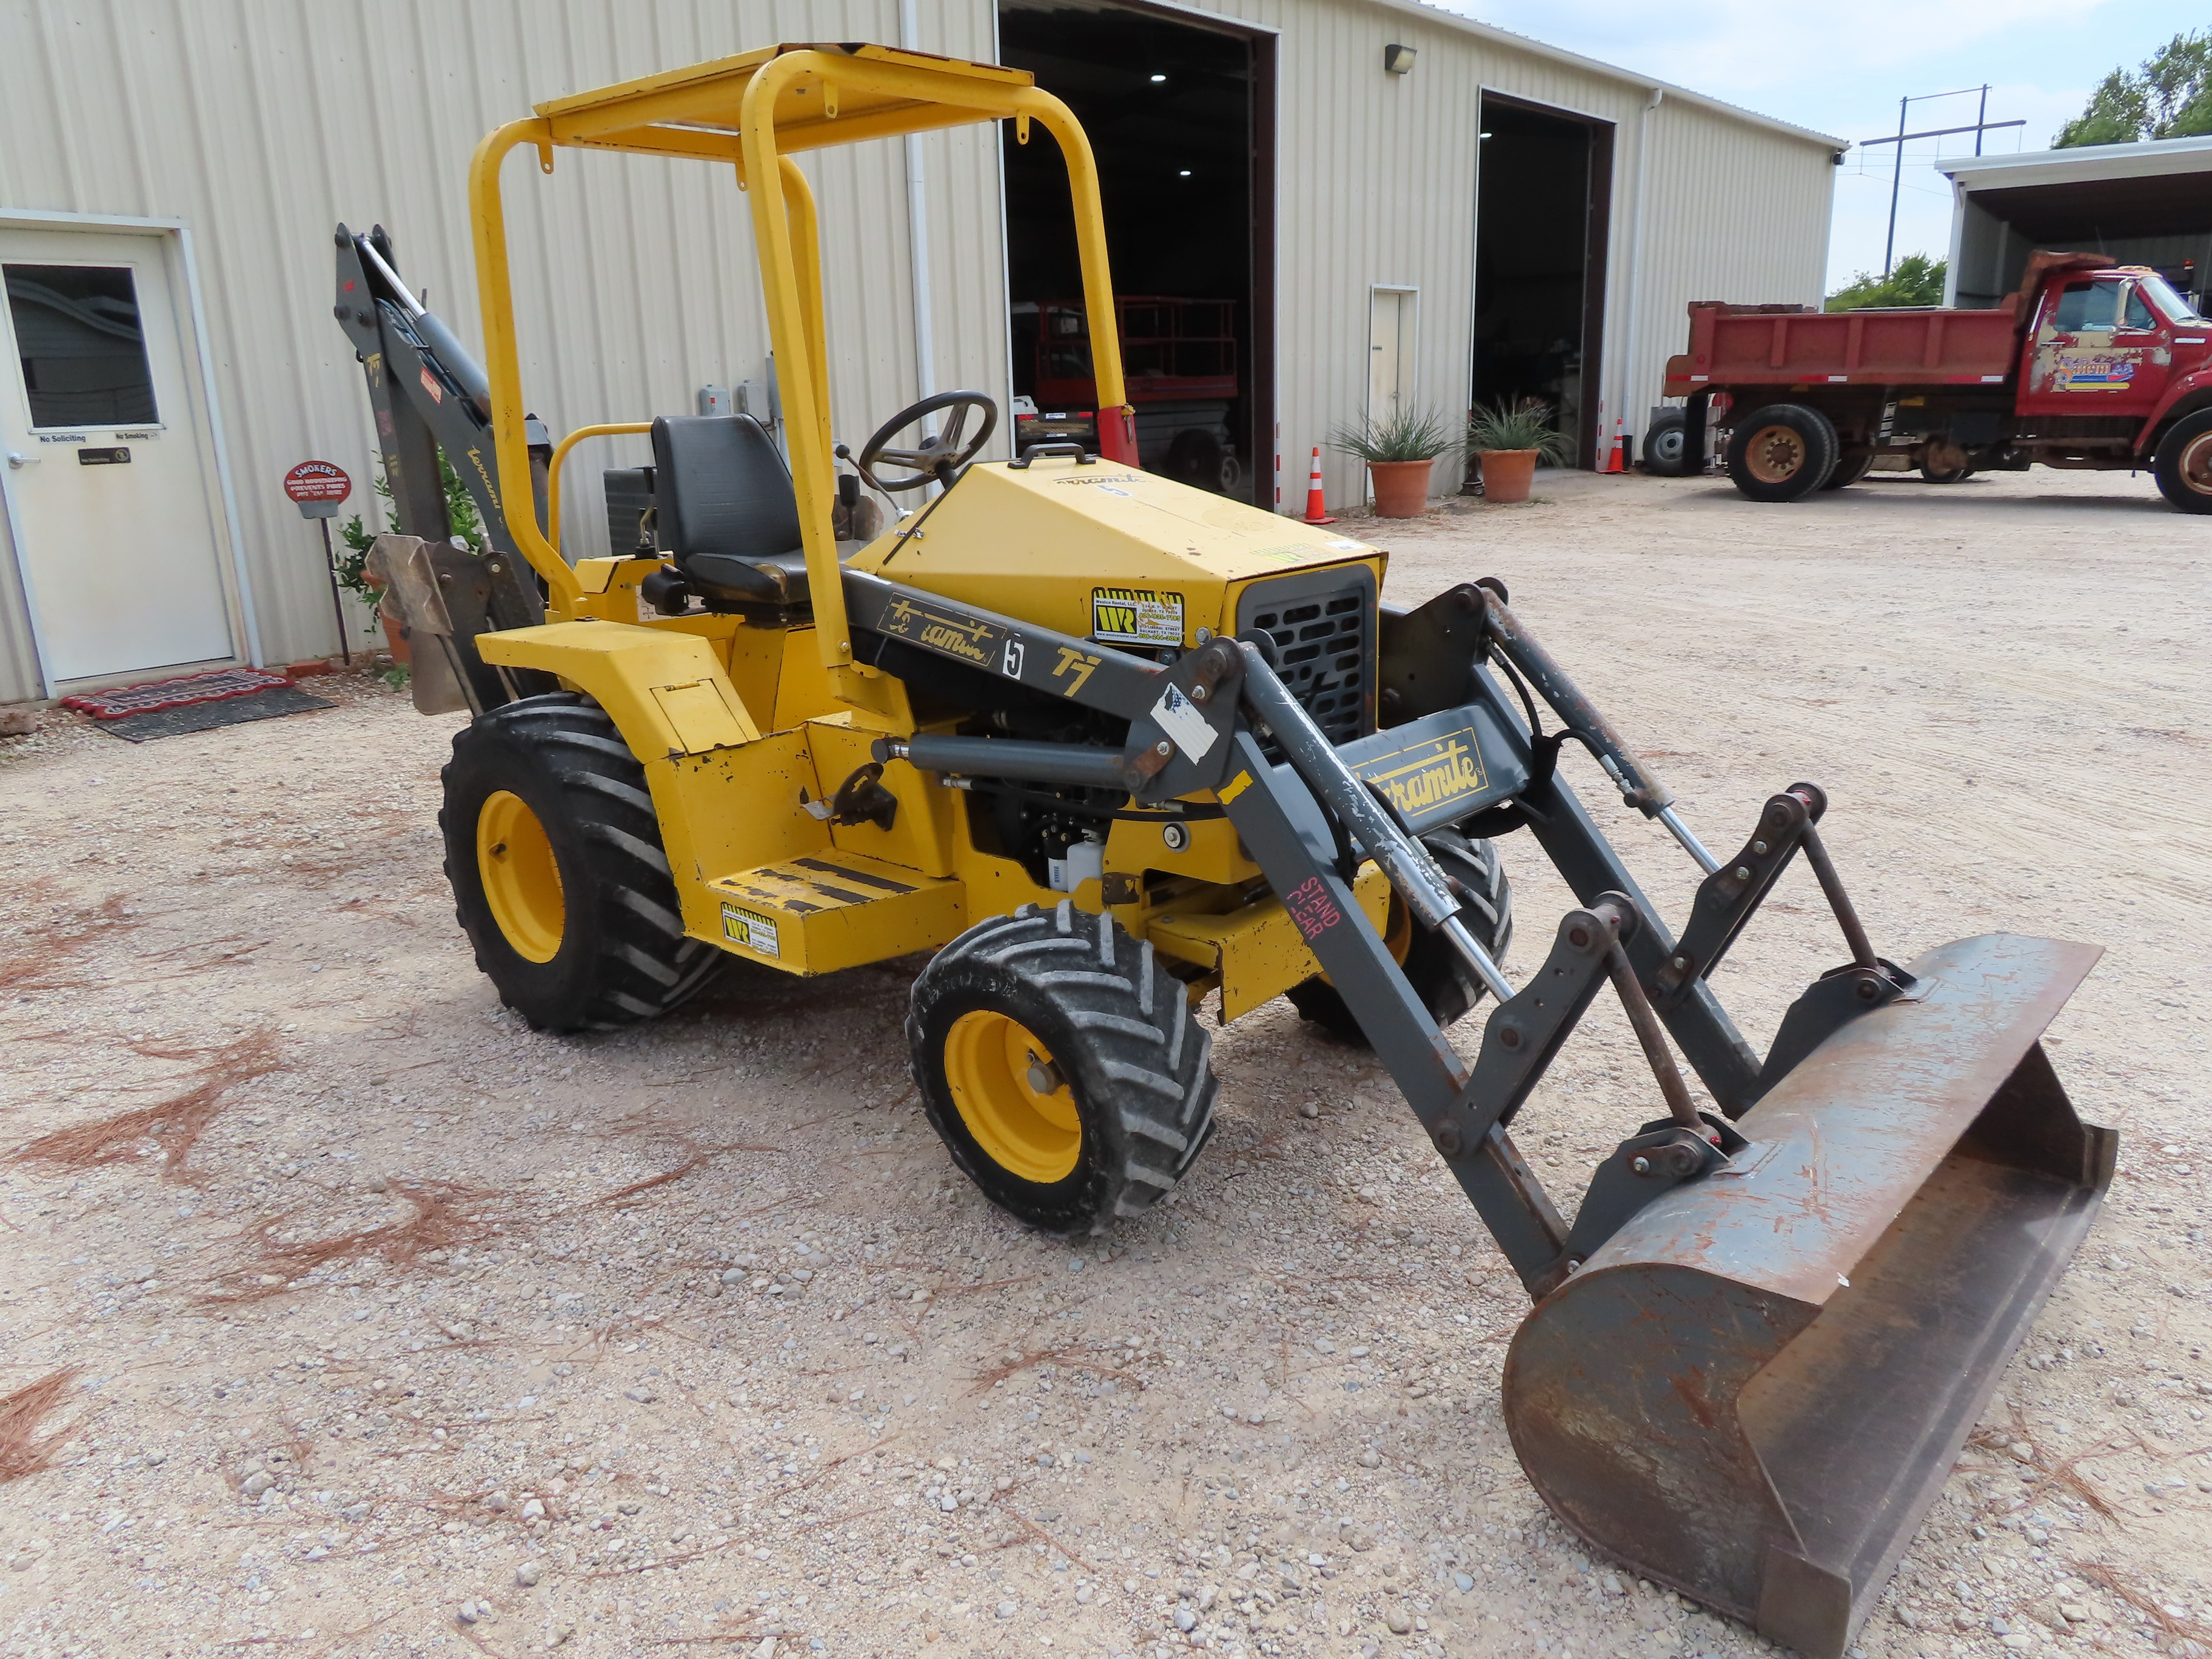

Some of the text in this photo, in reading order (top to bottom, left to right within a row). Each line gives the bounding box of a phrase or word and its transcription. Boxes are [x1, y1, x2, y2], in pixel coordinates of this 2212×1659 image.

[295, 464, 337, 478] SMOKERS
[468, 446, 503, 525] terrami
[1097, 484, 1130, 496] 5
[1097, 606, 1136, 633] WR
[1139, 612, 1181, 622] 806-935-7185
[1139, 633, 1181, 642] 806-244-3093
[1004, 634, 1024, 679] 5
[1355, 739, 1478, 813] rramite
[1301, 877, 1341, 927] STAND
[725, 916, 750, 943] WR
